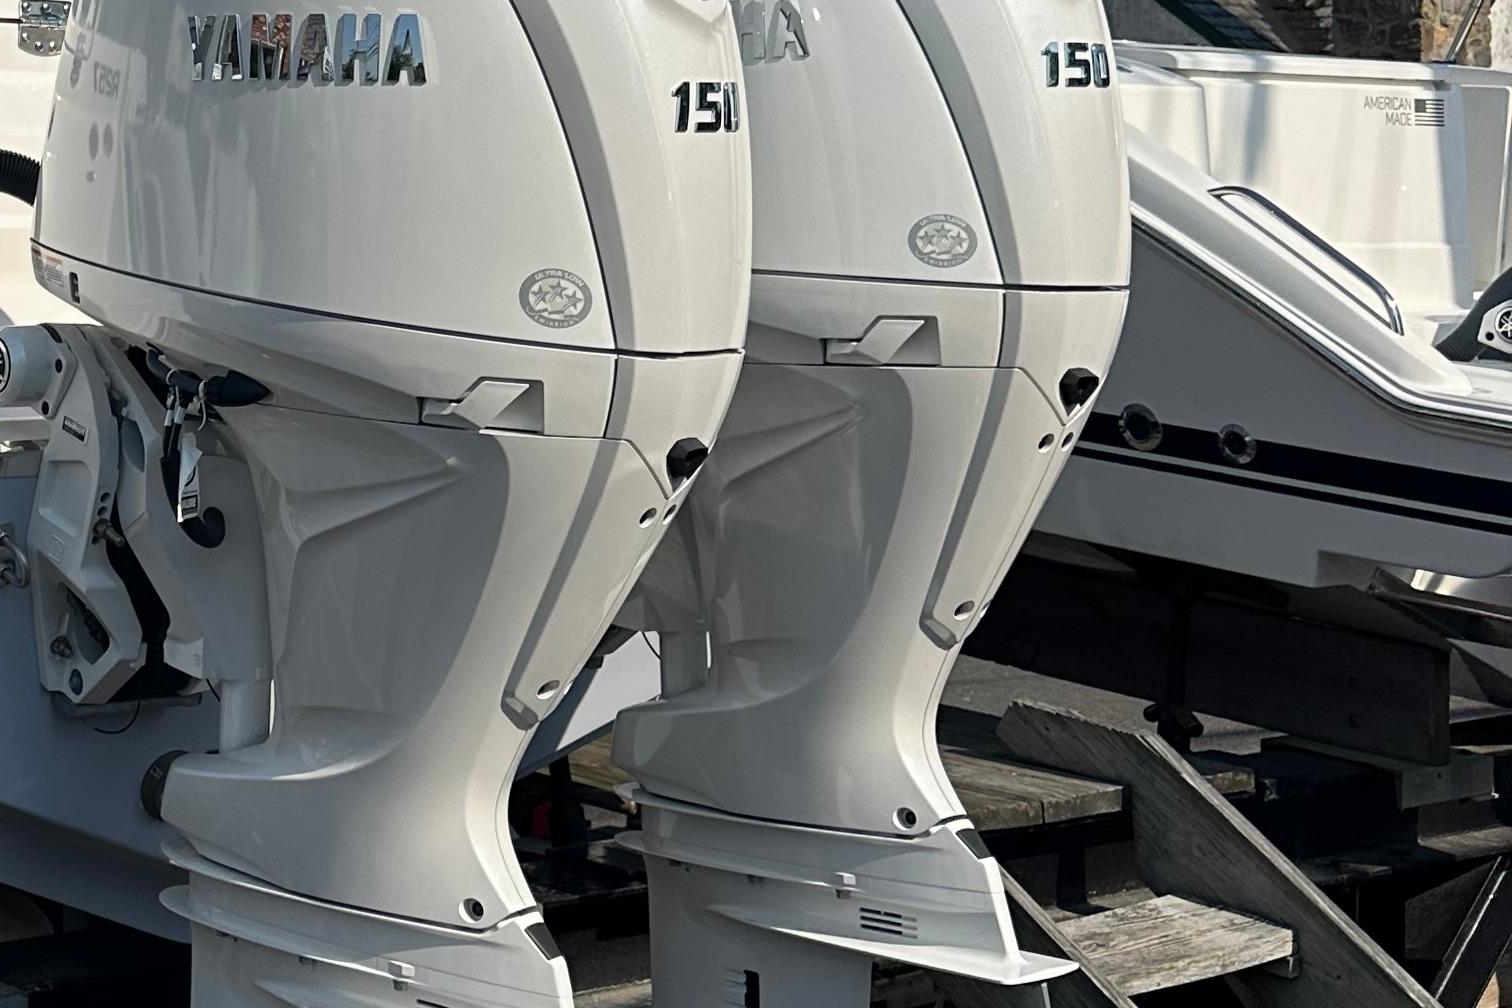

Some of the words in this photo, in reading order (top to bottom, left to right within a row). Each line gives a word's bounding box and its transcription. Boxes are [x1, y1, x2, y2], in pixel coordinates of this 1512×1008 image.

[187, 13, 428, 87] YAMAHA
[1040, 42, 1110, 88] 150
[671, 81, 739, 133] 150
[1363, 96, 1412, 111] AMERICAN
[1385, 112, 1412, 126] MADE
